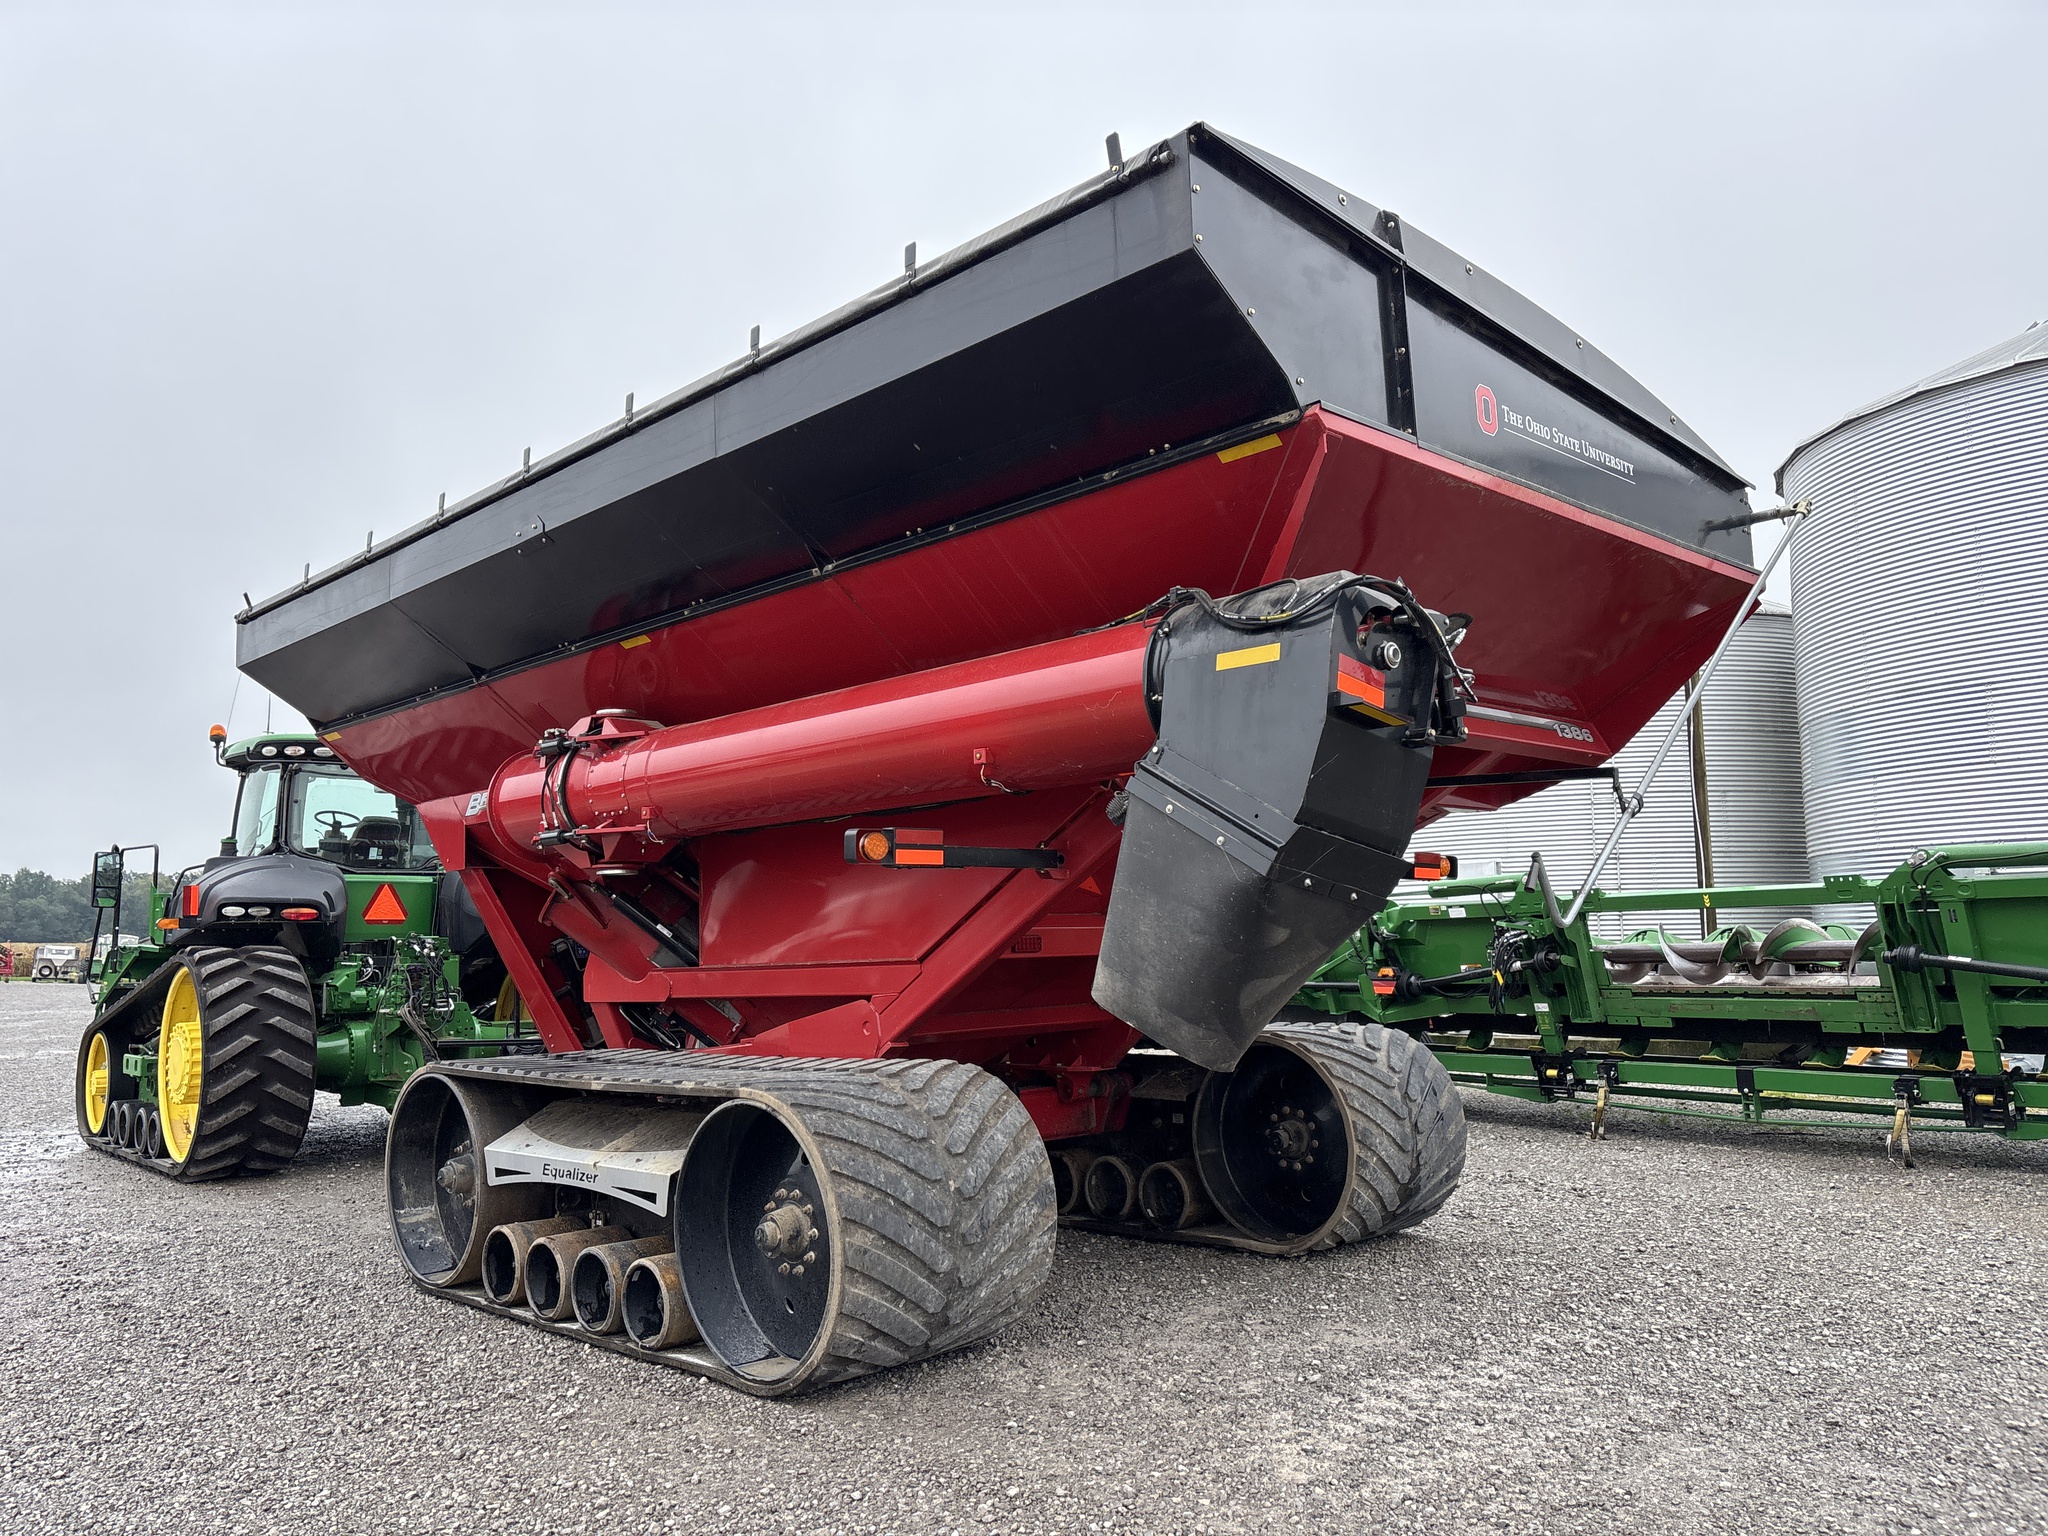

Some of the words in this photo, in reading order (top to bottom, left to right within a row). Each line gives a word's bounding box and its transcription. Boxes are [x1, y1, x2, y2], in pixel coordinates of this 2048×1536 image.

[1475, 384, 1498, 436] O
[1502, 405, 1523, 429] THE
[1525, 416, 1550, 439] OHIO
[1552, 428, 1580, 453] STATE
[1581, 440, 1634, 476] UNIVERSITY
[1553, 723, 1594, 743] 1386
[542, 1163, 599, 1184] Equalizer
